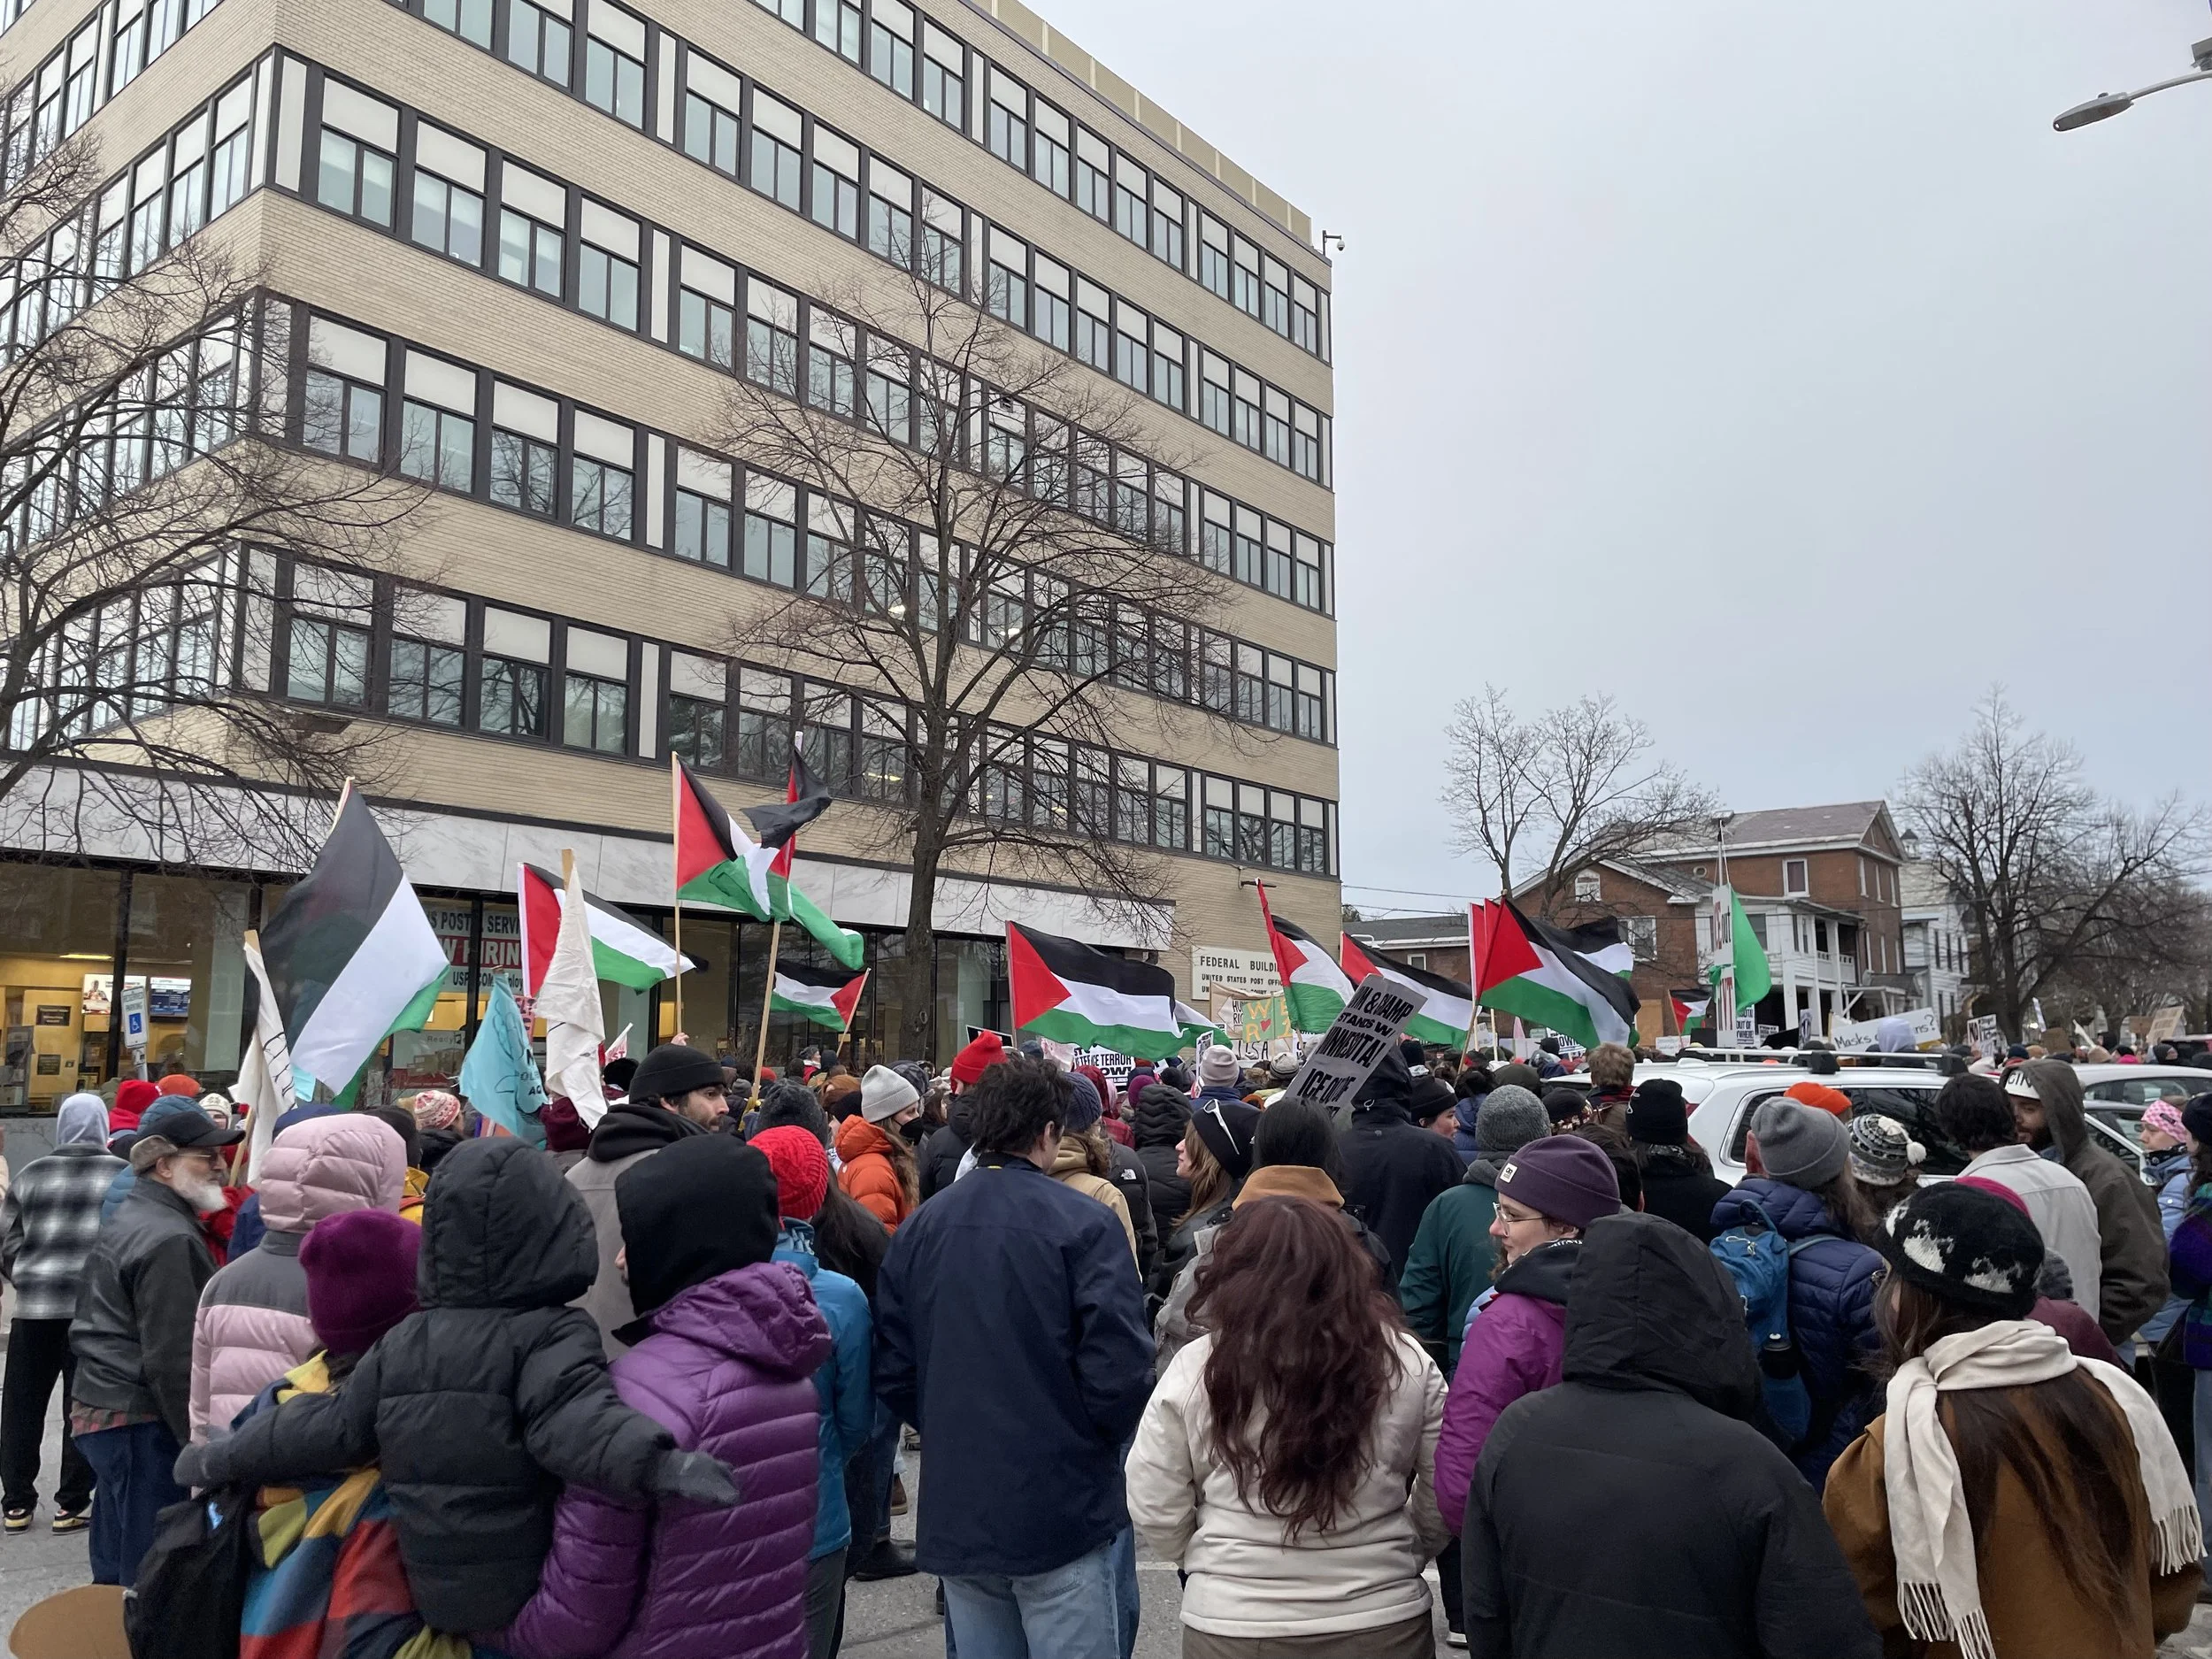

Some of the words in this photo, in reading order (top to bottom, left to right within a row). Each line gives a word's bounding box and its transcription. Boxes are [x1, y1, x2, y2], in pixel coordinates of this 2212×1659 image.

[463, 939, 521, 968] HIRIN
[1200, 956, 1240, 970] FEDERAL
[1250, 960, 1279, 973] BUILDI
[1202, 973, 1223, 982] UNTED
[1227, 975, 1247, 984] STATES
[1338, 1012, 1377, 1028] STANDS
[1834, 1033, 1872, 1048] Masks
[1101, 1053, 1132, 1065] TERROR
[1297, 1068, 1333, 1101] ICE
